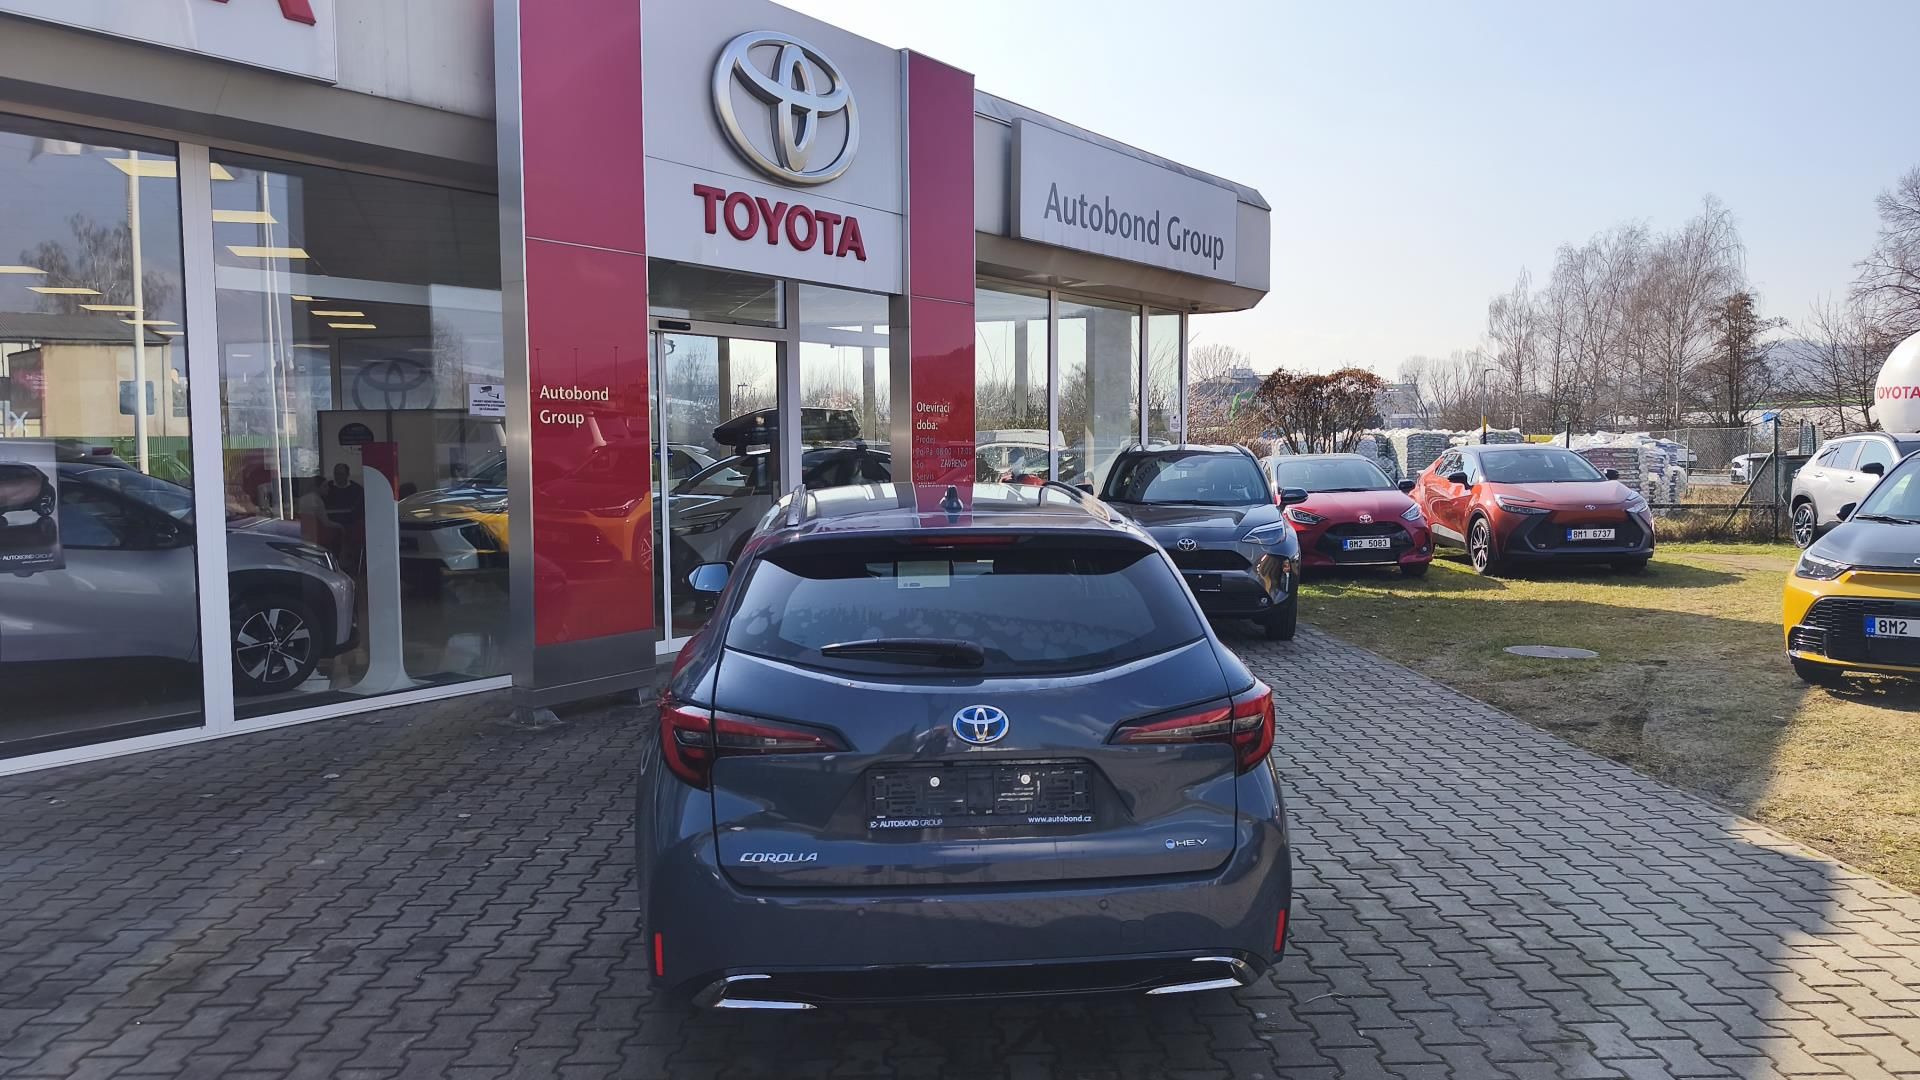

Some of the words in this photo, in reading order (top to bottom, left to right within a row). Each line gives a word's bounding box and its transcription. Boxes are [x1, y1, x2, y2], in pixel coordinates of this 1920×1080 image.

[693, 183, 866, 262] TOYOTA
[1043, 182, 1160, 246] Autobond
[1167, 216, 1224, 270] Group
[539, 384, 609, 401] Autobond
[1877, 386, 1920, 400] TOYOTA
[916, 401, 950, 413] Otevírací
[539, 409, 585, 428] Group
[916, 419, 938, 430] doba:
[1573, 530, 1587, 538] 8M1
[1592, 529, 1611, 538] 6737
[1348, 540, 1363, 548] 8M2
[1368, 539, 1387, 548] 5083
[1878, 619, 1908, 635] 8M2
[879, 819, 919, 828] AUTOBOND
[920, 818, 943, 827] GROUP
[1028, 815, 1092, 824] www.autobond.cz
[1176, 838, 1208, 847] HEV
[740, 852, 818, 863] COROLLA
